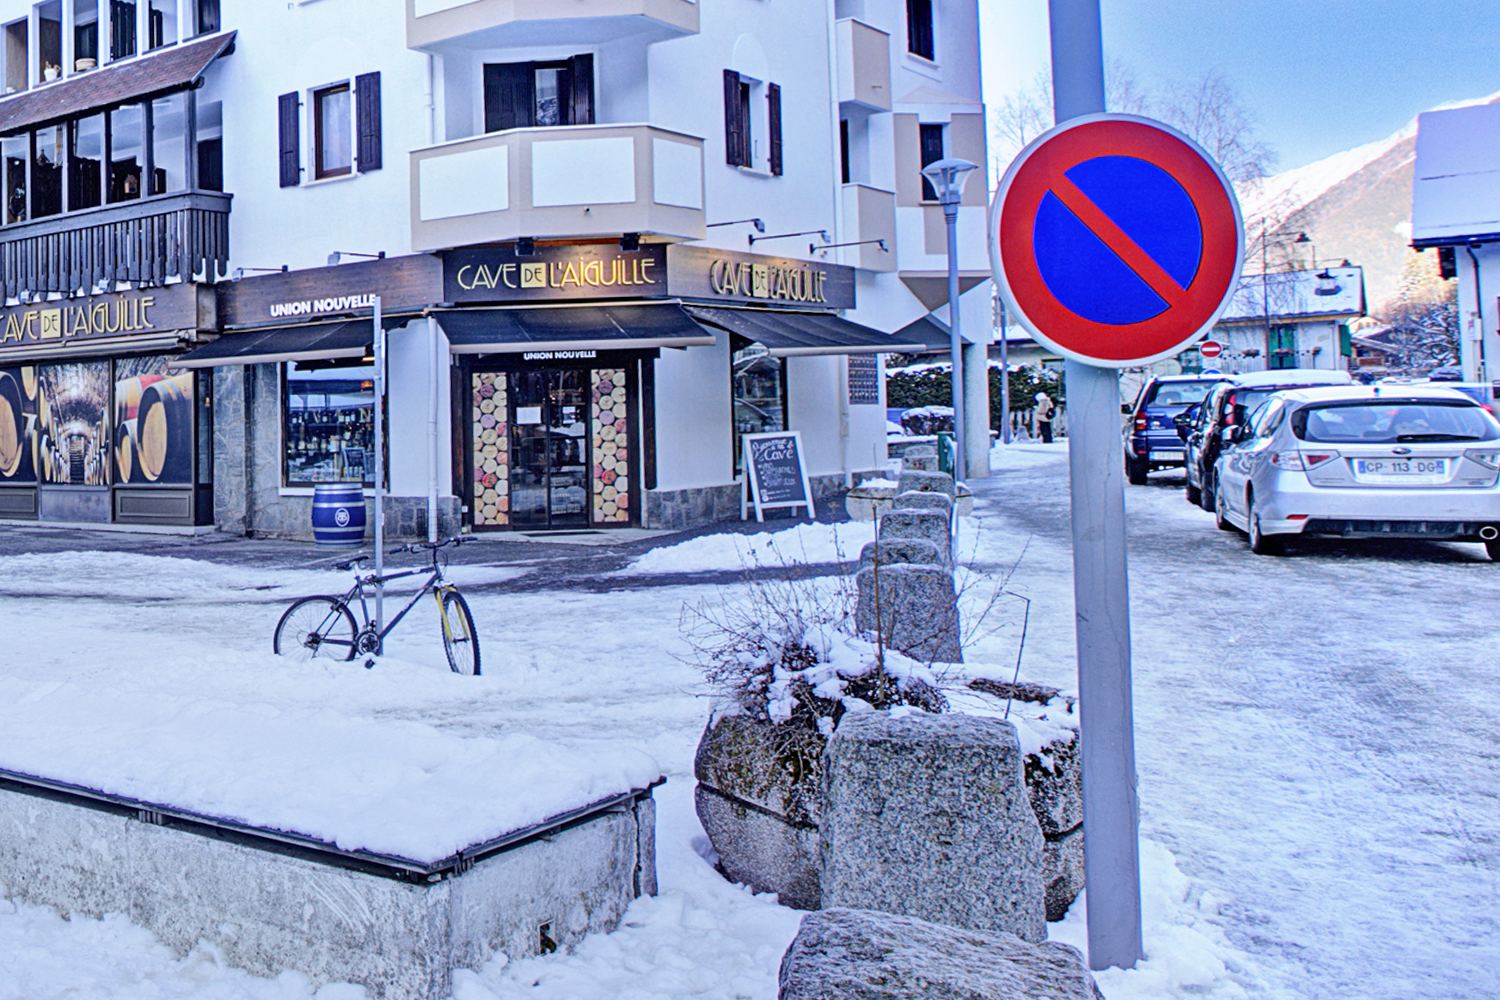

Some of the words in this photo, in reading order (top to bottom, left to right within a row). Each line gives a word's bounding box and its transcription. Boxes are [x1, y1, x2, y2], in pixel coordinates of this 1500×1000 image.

[457, 263, 517, 289] CAVE
[523, 266, 544, 284] DE
[710, 260, 751, 296] CAVE
[270, 301, 311, 317] UNION
[313, 294, 376, 312] NOUVELLE
[42, 312, 60, 334] DE
[523, 352, 553, 360] UNION
[554, 350, 597, 359] NOUVELLE
[764, 448, 794, 460] Cave
